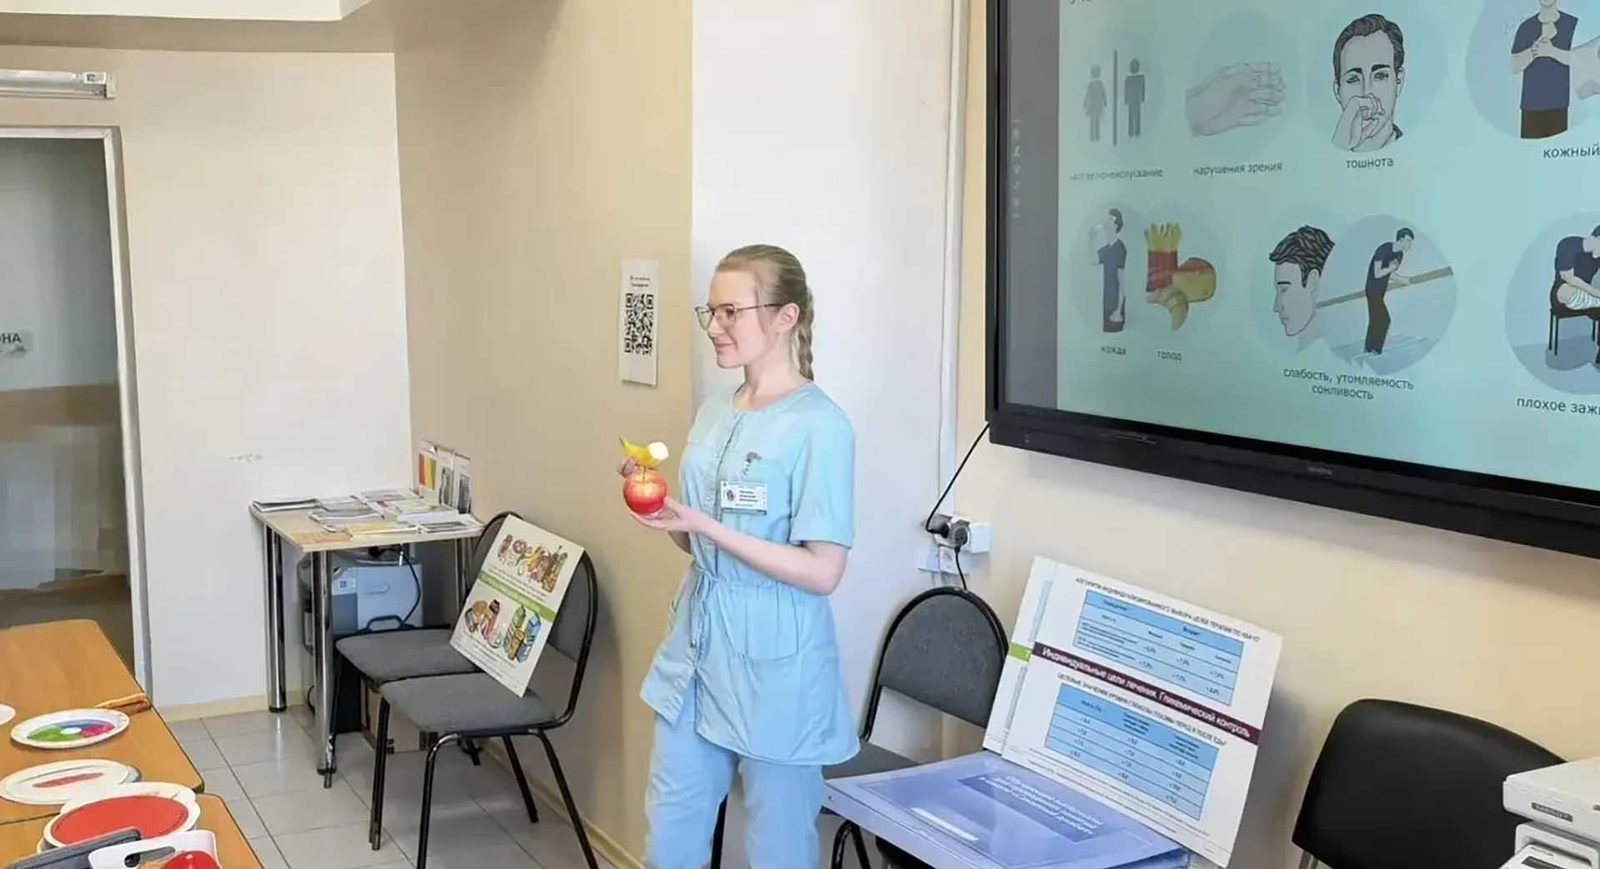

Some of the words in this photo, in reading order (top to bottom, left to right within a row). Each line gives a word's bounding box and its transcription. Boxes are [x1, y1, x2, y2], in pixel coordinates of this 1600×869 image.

[1543, 143, 1600, 159] кожный
[1193, 164, 1245, 176] нарушения
[1247, 161, 1283, 174] зрения
[1346, 158, 1394, 169] тошнота
[0, 332, 22, 345] НА
[1283, 367, 1333, 383] слабость,
[1335, 373, 1414, 390] утомляемость
[1311, 384, 1374, 400] сонливость
[1516, 397, 1567, 412] плохое
[1570, 402, 1600, 416] заж
